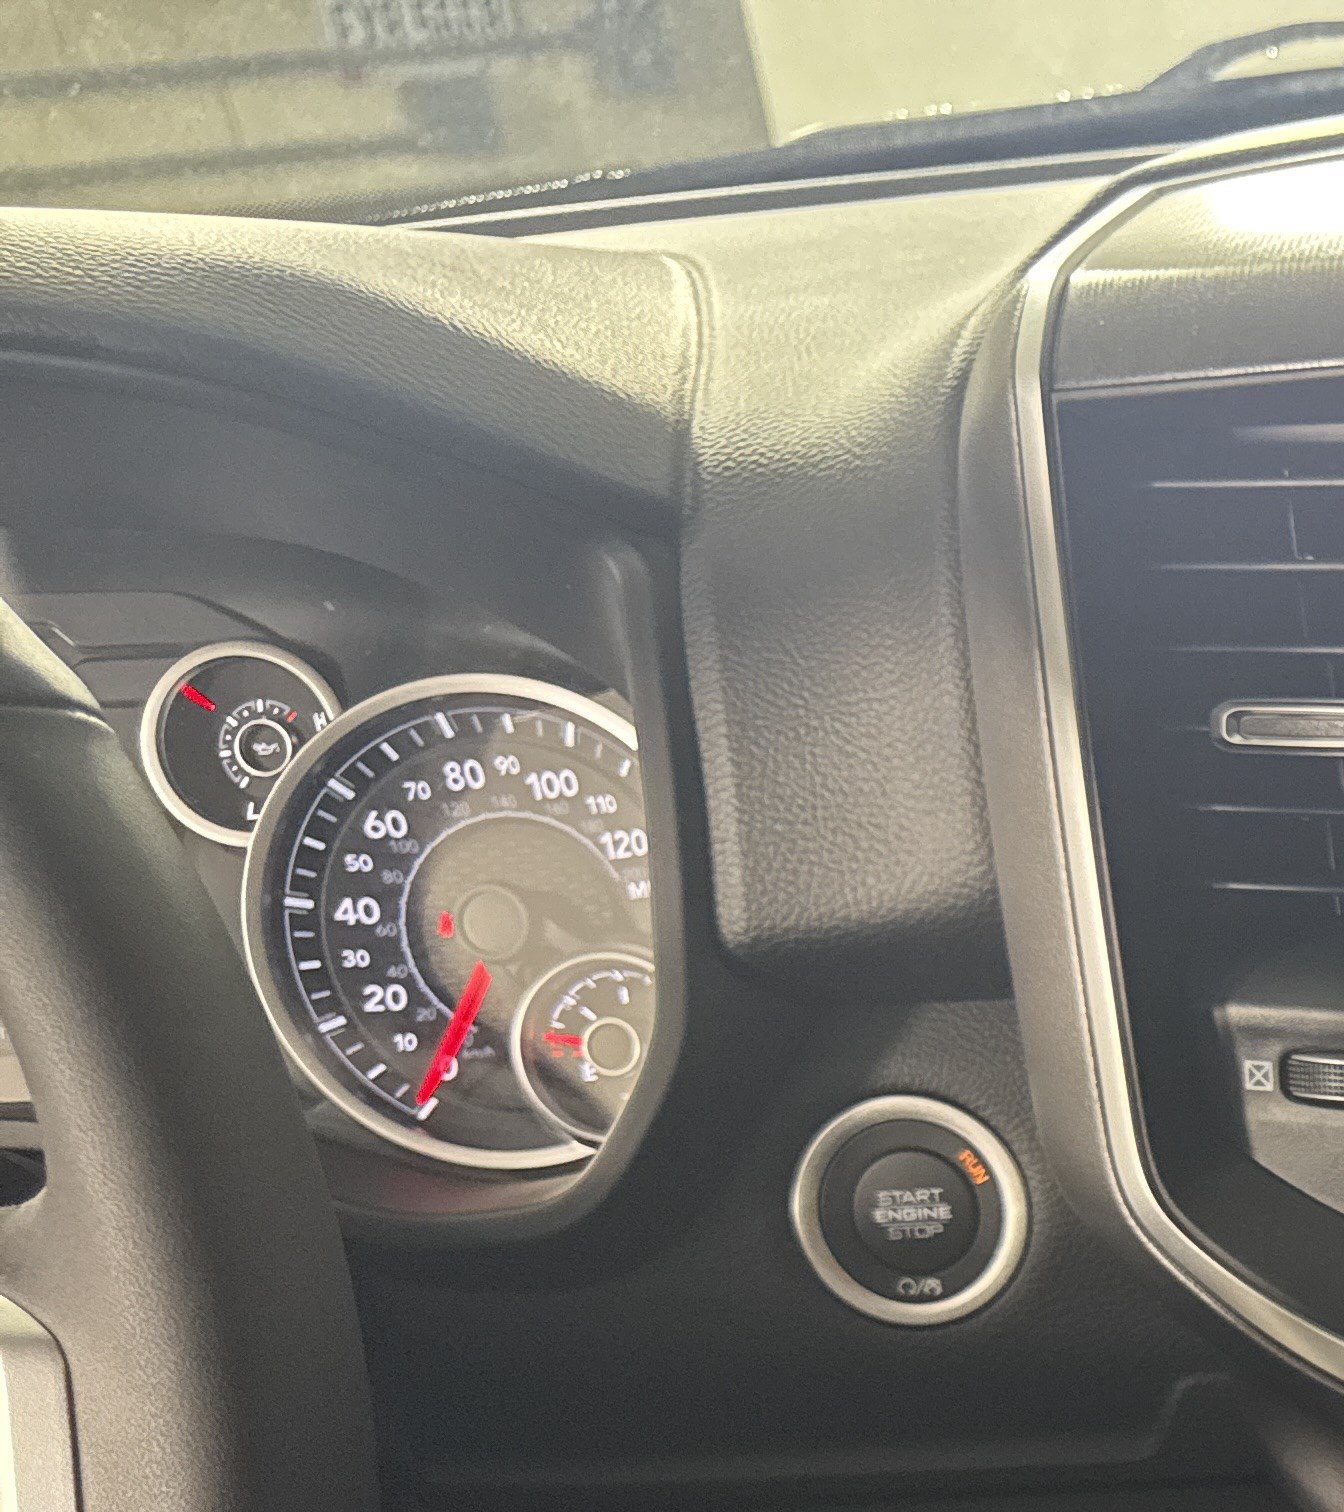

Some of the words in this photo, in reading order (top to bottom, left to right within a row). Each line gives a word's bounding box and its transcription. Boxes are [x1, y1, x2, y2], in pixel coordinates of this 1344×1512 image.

[443, 758, 486, 792] 80
[494, 755, 521, 776] 90
[402, 780, 432, 801] 70
[524, 768, 579, 801] 100
[585, 794, 618, 815] 110
[364, 809, 408, 839] 60
[599, 827, 649, 860] 120
[344, 853, 373, 873] 50
[334, 897, 381, 925] 40
[341, 949, 370, 969] 30
[363, 983, 408, 1012] 20
[393, 1031, 418, 1053] 10
[957, 1148, 990, 1185] RUN
[877, 1187, 944, 1206] START
[872, 1206, 953, 1224] ENGINE
[886, 1223, 944, 1241] STOP
